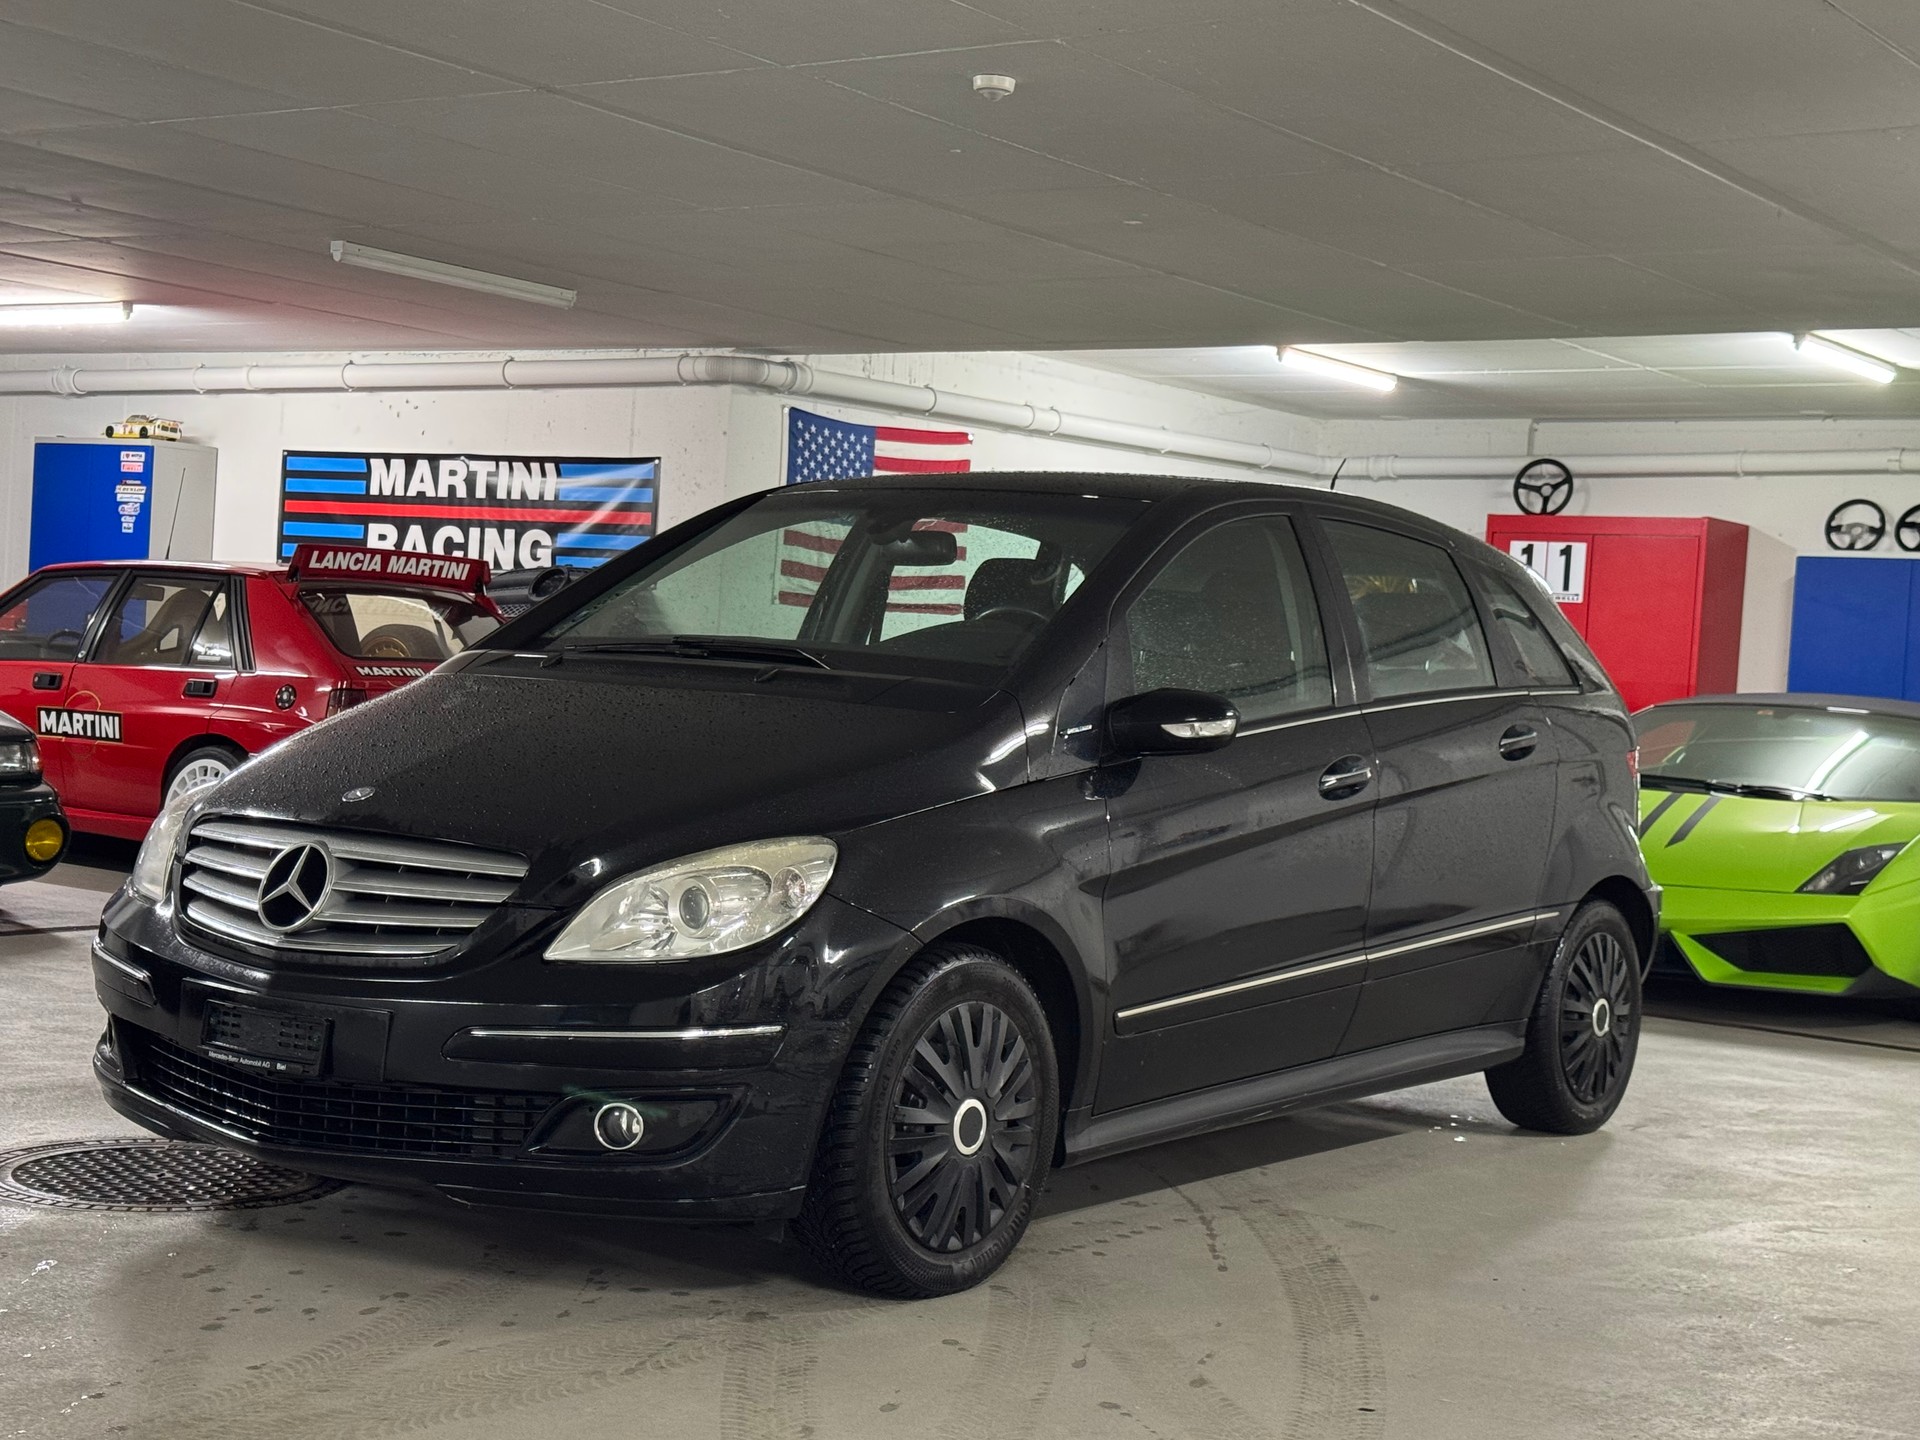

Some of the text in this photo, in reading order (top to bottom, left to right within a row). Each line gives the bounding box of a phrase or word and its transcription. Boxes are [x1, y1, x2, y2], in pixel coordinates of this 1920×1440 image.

[369, 458, 557, 501] MARTINI
[367, 523, 553, 570] RACING
[308, 550, 471, 581] LANCIA MARTINI
[356, 666, 426, 677] MARTINI
[40, 710, 120, 739] MARTINI
[208, 1051, 287, 1071] Mercedes-Benz Automobil AG Biel
